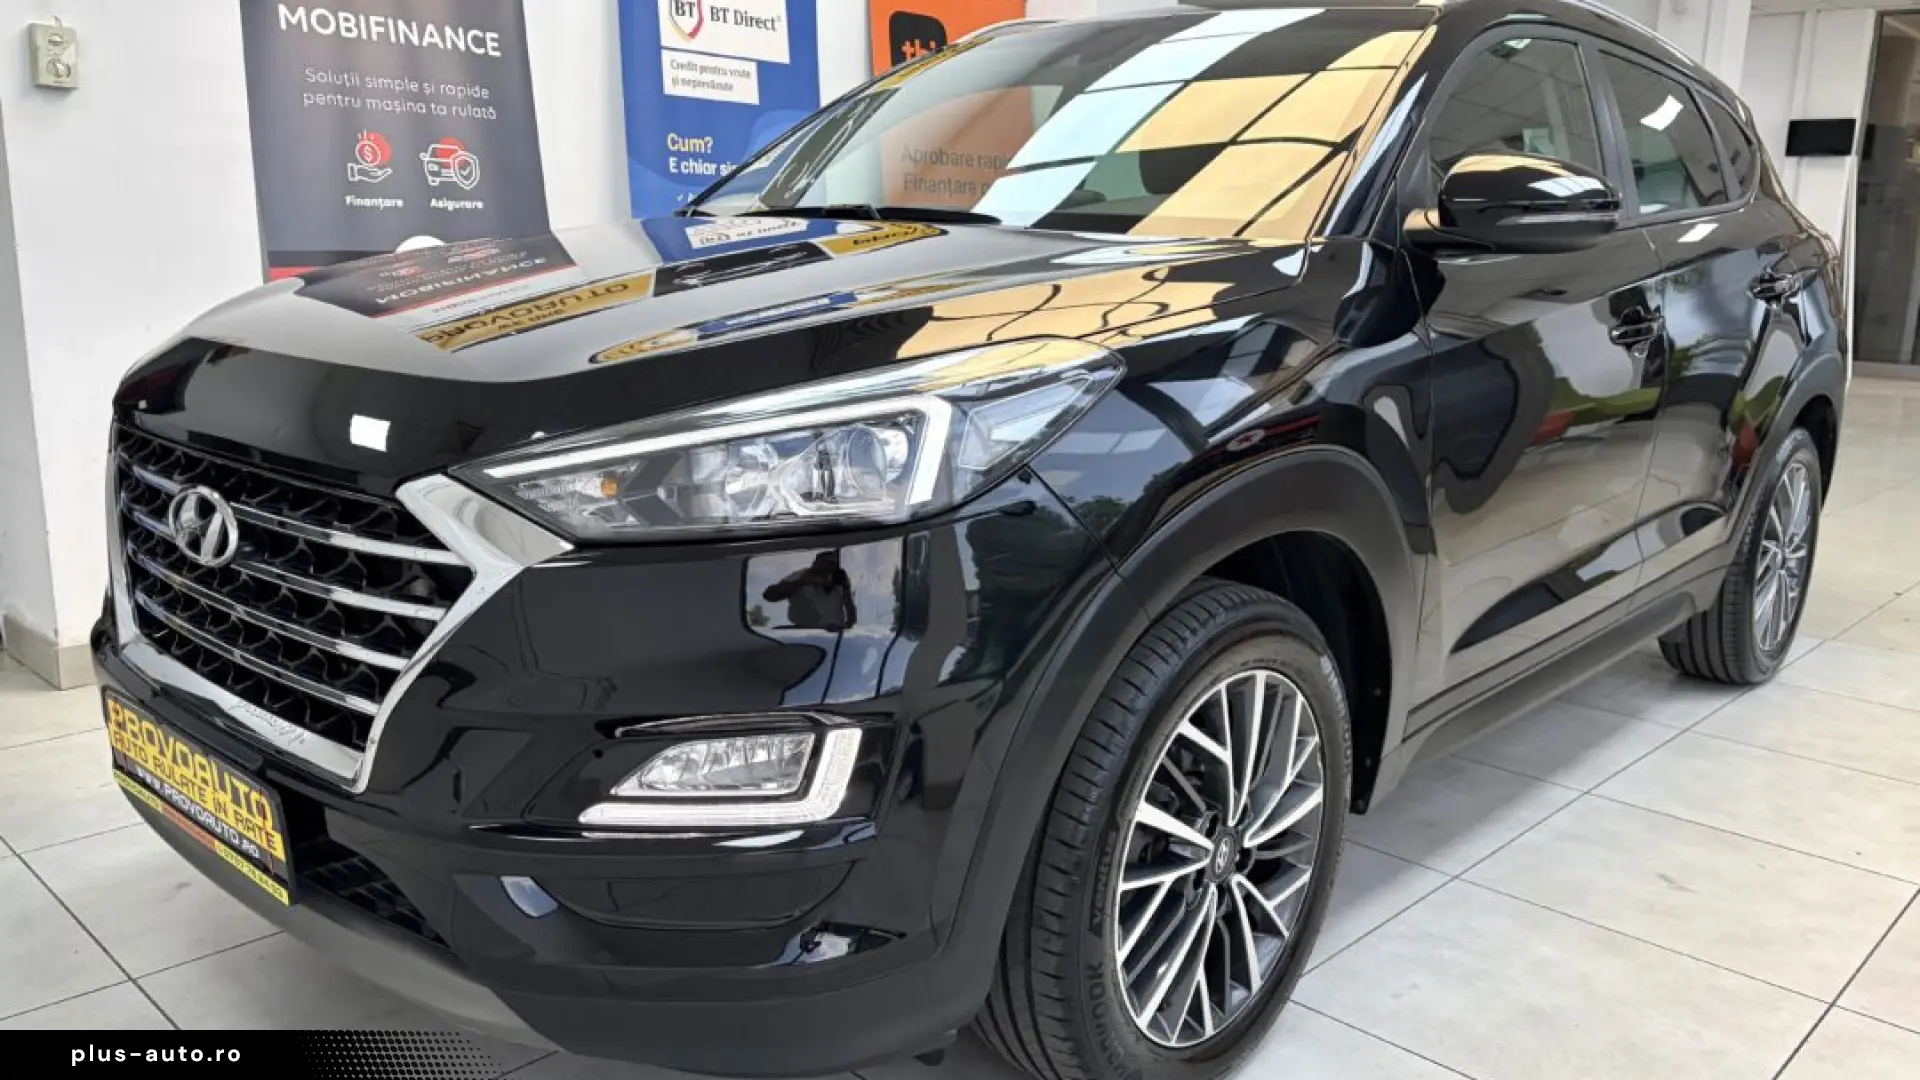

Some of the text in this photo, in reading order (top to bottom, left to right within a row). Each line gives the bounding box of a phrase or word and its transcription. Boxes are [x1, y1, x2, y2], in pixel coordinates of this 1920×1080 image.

[710, 5, 730, 24] BT
[277, 3, 502, 57] MOBIFINANCE
[699, 64, 728, 77] pentru
[365, 75, 419, 94] simple
[440, 84, 490, 99] rapide
[303, 92, 361, 108] pentru
[430, 102, 447, 116] ta
[667, 132, 714, 154] Cum?
[669, 157, 679, 174] E
[680, 157, 717, 175] chiar
[901, 144, 975, 167] Aprobare
[430, 197, 485, 212] Asigurare
[113, 729, 149, 764] AUTO
[107, 697, 273, 827] PROVOAUTO
